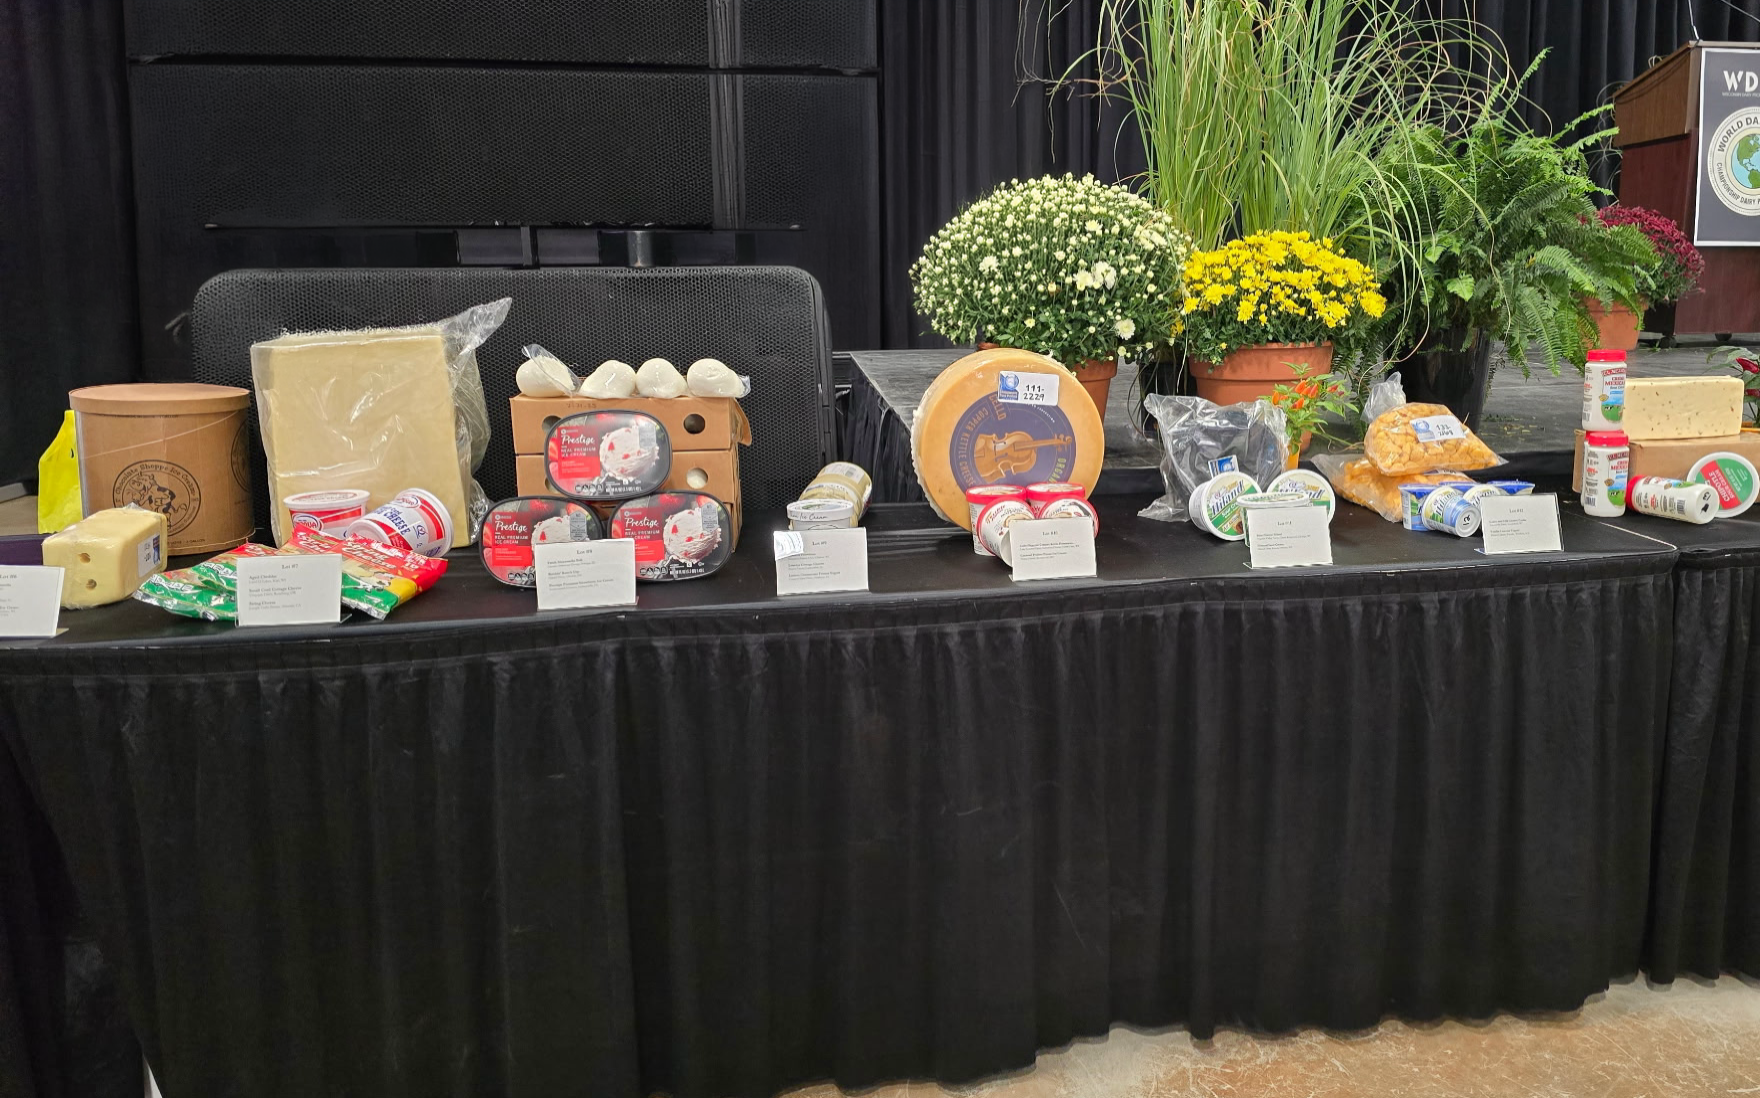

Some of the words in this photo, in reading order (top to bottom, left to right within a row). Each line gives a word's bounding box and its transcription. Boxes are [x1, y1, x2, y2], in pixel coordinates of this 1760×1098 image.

[1723, 70, 1758, 92] WD
[1718, 120, 1743, 152] WORLD
[1716, 162, 1740, 200] CHAMPIONSHIP
[1740, 196, 1756, 205] DAIRY
[966, 407, 989, 431] COPPER
[989, 394, 1006, 420] CELLO
[562, 434, 595, 444] Prestige
[959, 432, 969, 458] KETTLE
[116, 468, 138, 495] Chocolate
[170, 467, 181, 476] Ice
[181, 474, 195, 496] Cream
[959, 459, 975, 486] CHEESE
[1211, 480, 1244, 516] Hiland
[1709, 471, 1730, 501] CHIPOTLE
[383, 510, 410, 536] CHEESE
[495, 520, 528, 533] Prestige
[625, 516, 659, 528] Prestige
